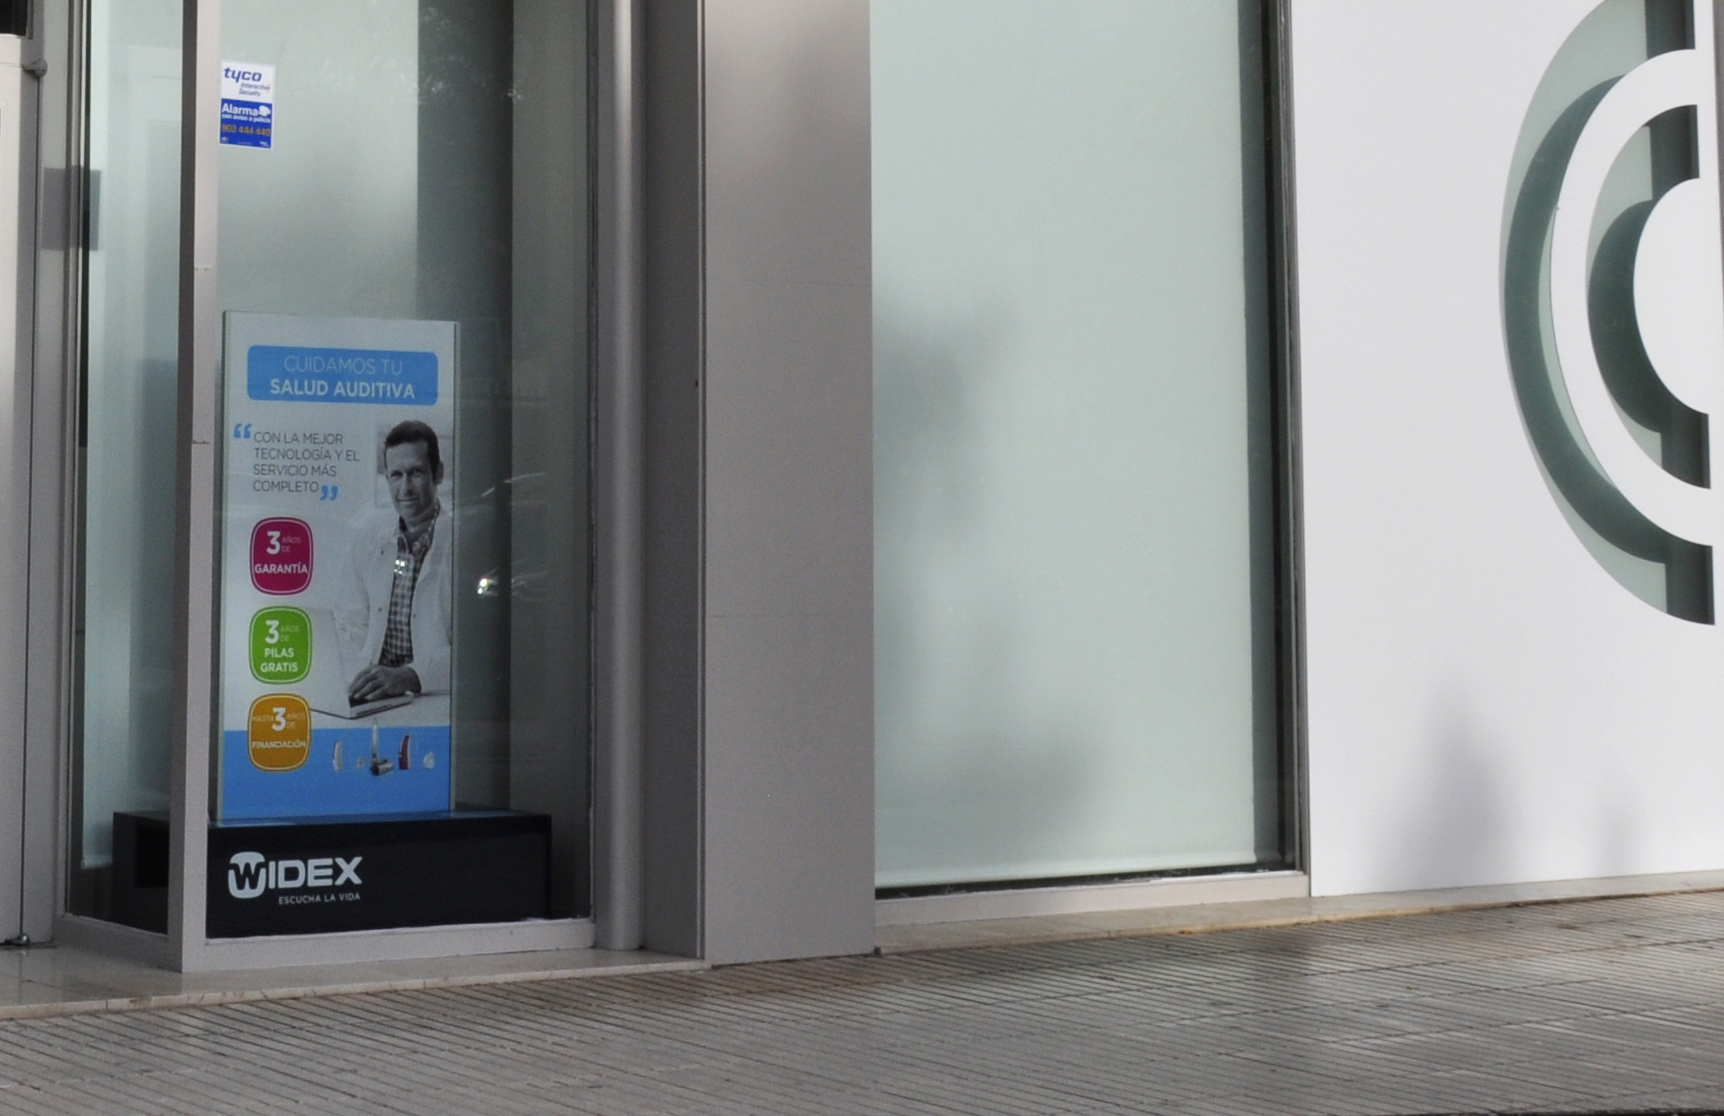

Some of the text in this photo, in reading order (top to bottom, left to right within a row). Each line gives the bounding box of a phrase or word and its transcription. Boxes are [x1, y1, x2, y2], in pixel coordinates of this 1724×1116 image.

[223, 66, 263, 83] tyco
[238, 88, 262, 97] Security
[221, 102, 259, 116] Alarma
[283, 355, 404, 376] CUIDAMOS TU
[269, 378, 416, 399] SALUD AUDITIVA
[283, 432, 300, 444] LA
[302, 433, 344, 445] MEJOR
[253, 446, 360, 462] TECNOLOGÍA Y EL
[252, 462, 337, 476] SERVICIO MÁS
[266, 530, 281, 555] 3
[254, 561, 309, 575] GARANTÍA
[265, 619, 280, 644] 3
[264, 647, 295, 658] PILAS
[260, 662, 299, 673] GRATIS
[271, 707, 287, 731] 3
[227, 851, 363, 899] WIDEX
[278, 892, 361, 905] ESCUCHA LA VIDA
